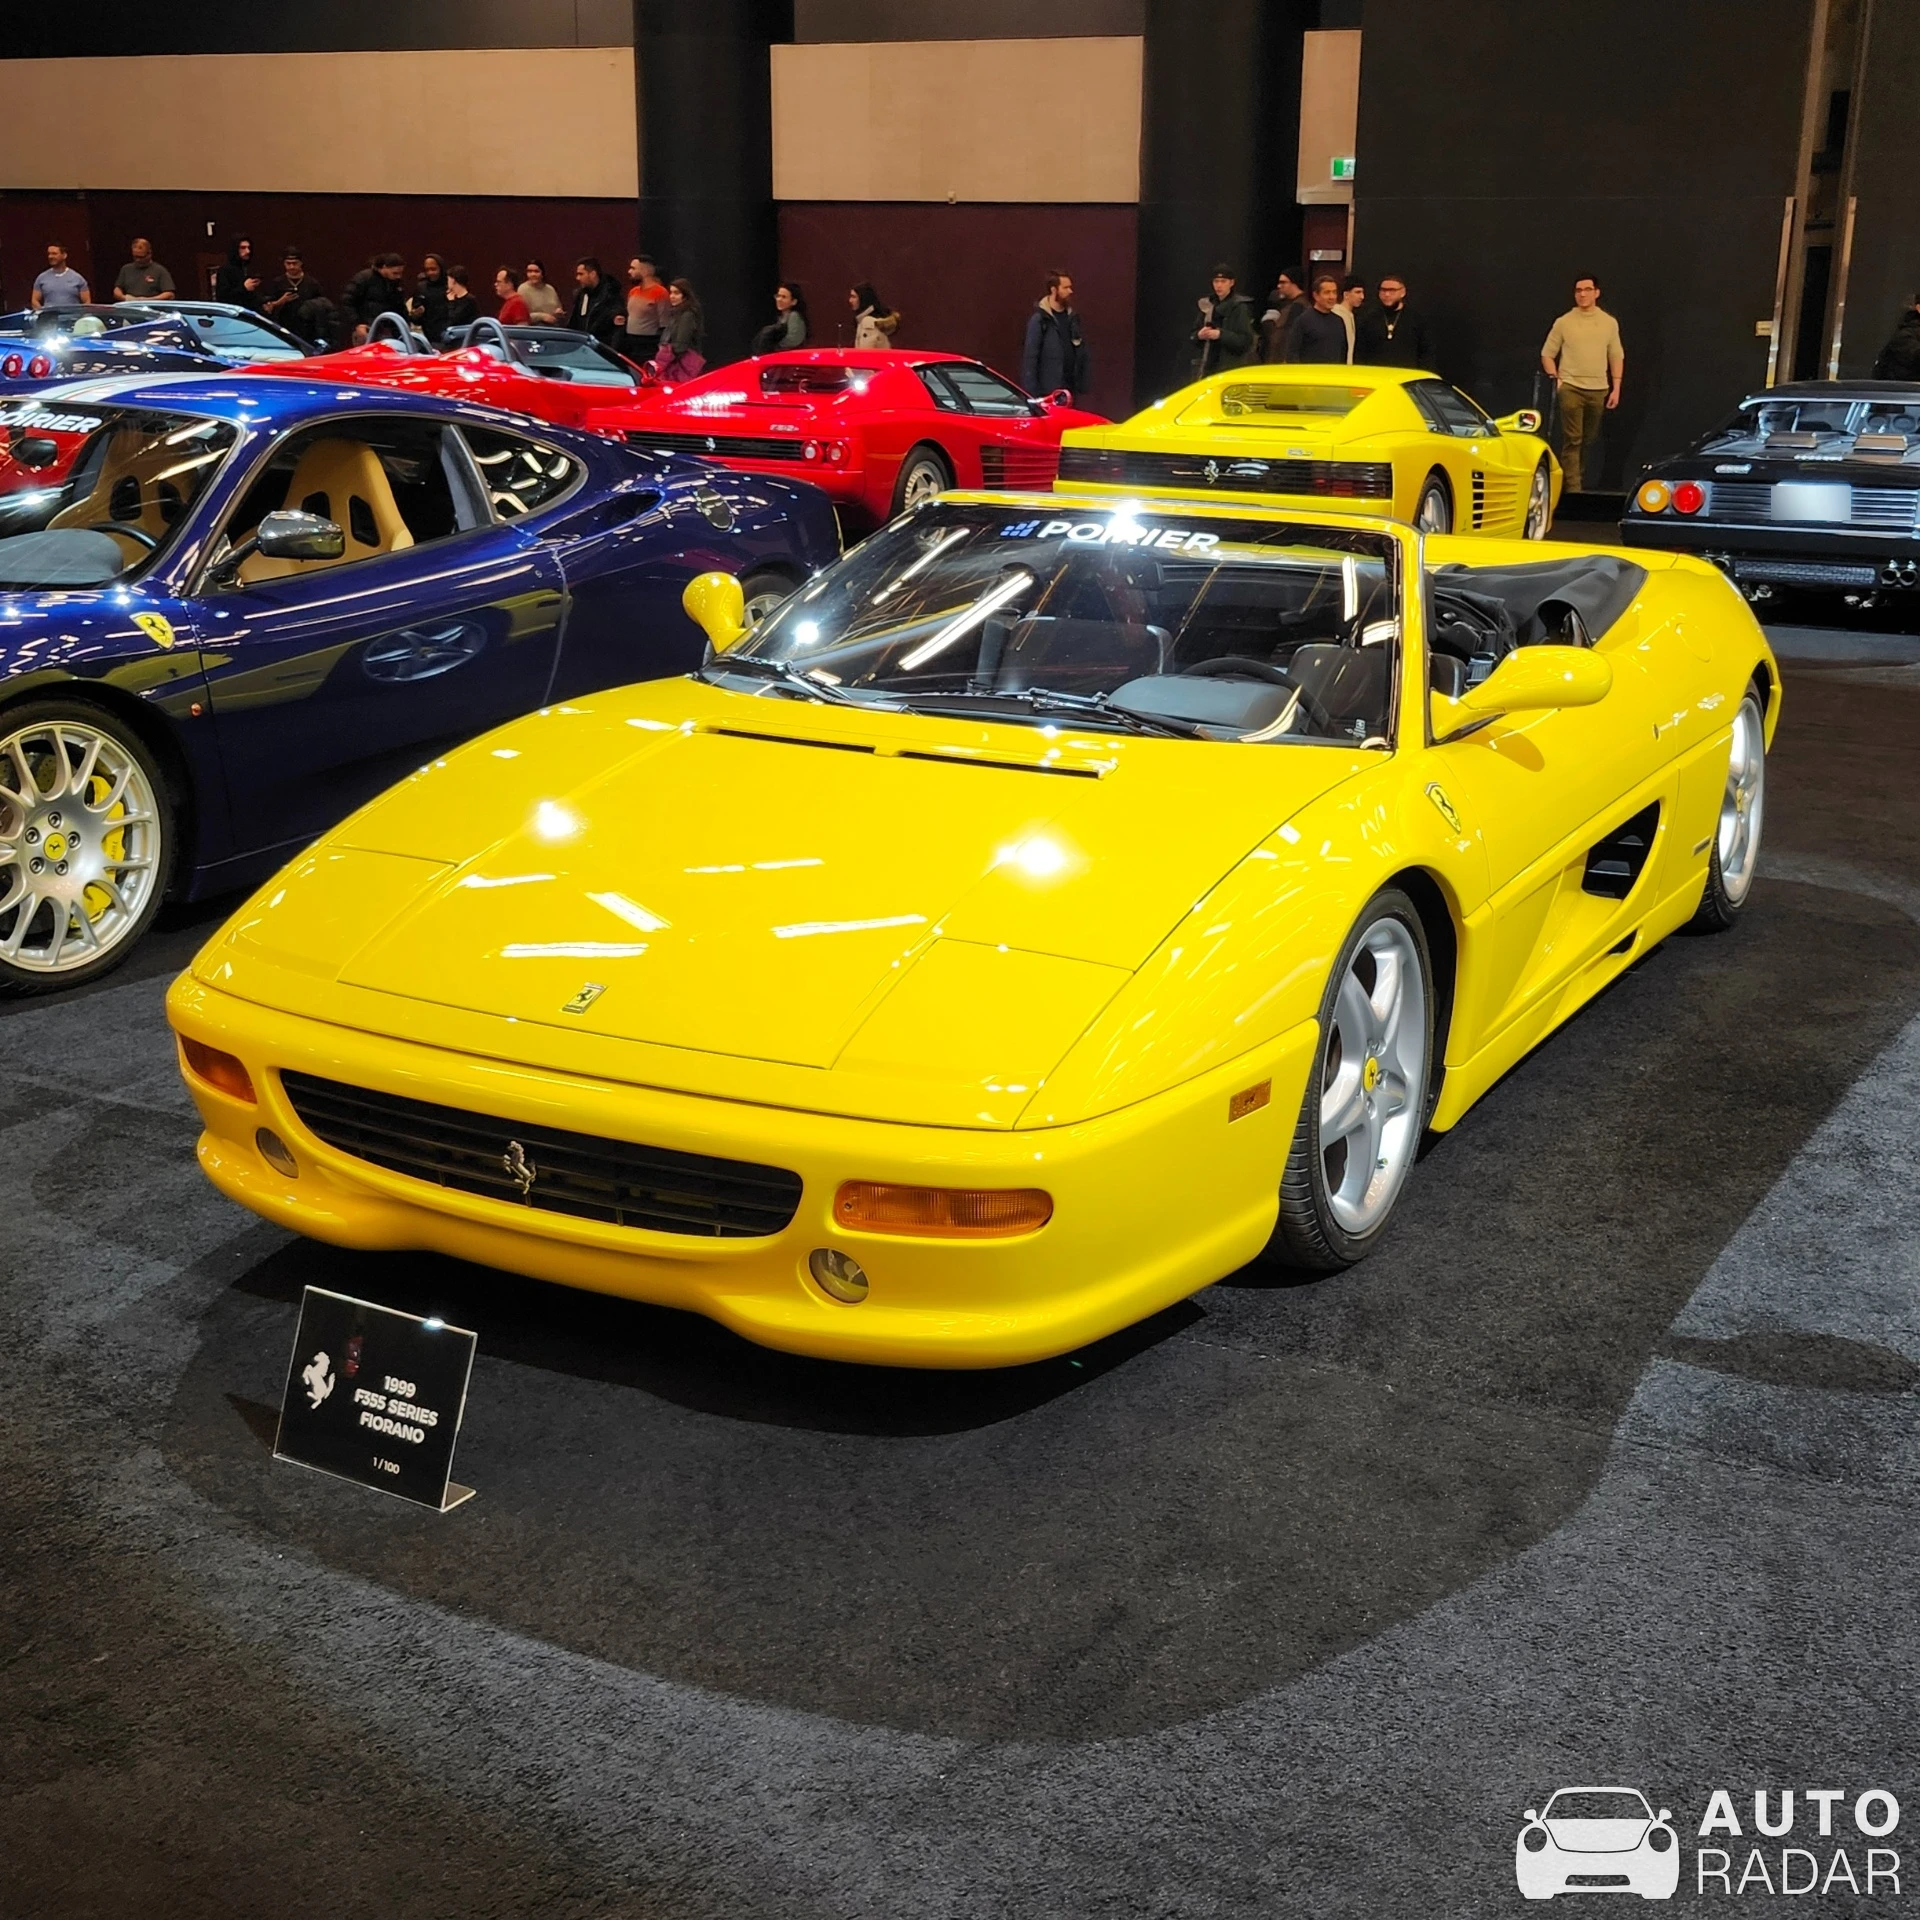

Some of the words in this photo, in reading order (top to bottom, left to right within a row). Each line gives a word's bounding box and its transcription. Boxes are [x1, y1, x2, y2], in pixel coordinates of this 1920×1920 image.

[0, 410, 103, 434] OIRIER
[384, 1375, 417, 1399] 1999
[354, 1388, 388, 1411] F355
[387, 1399, 439, 1427] SERIES
[360, 1411, 426, 1444] FIORANO
